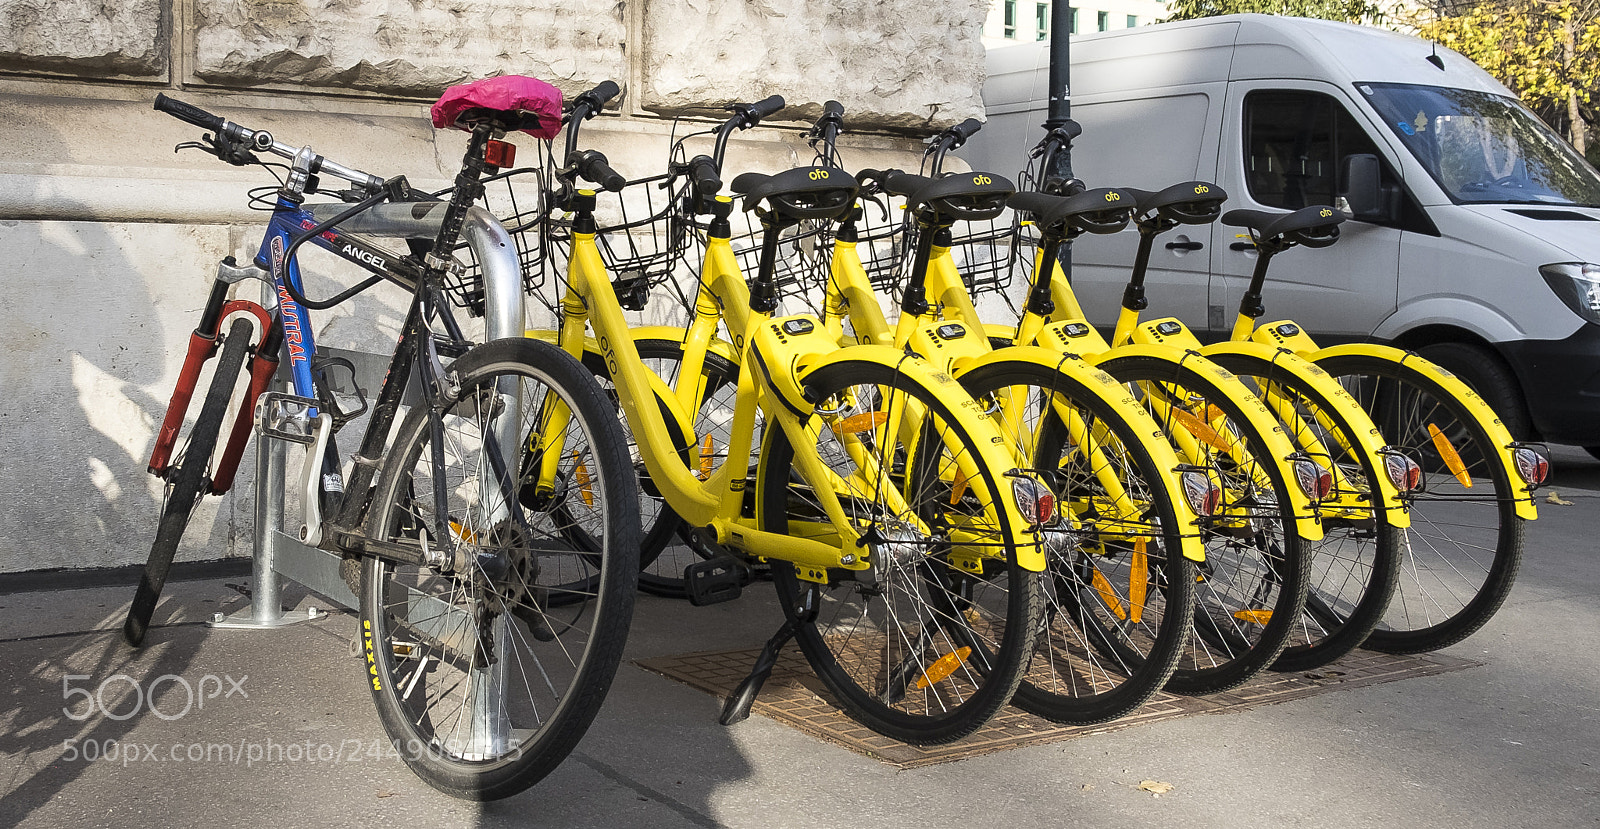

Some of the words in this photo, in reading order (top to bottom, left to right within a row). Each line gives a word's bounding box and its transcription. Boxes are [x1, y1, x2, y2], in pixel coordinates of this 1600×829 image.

[808, 168, 829, 181] ofo
[973, 174, 992, 186] ofo
[1194, 184, 1209, 194] ofo
[1105, 191, 1120, 202] ofo
[1319, 207, 1333, 218] ofo
[342, 244, 388, 272] ANGEL
[278, 285, 307, 367] MISTRAL
[363, 620, 382, 691] MAXXIS
